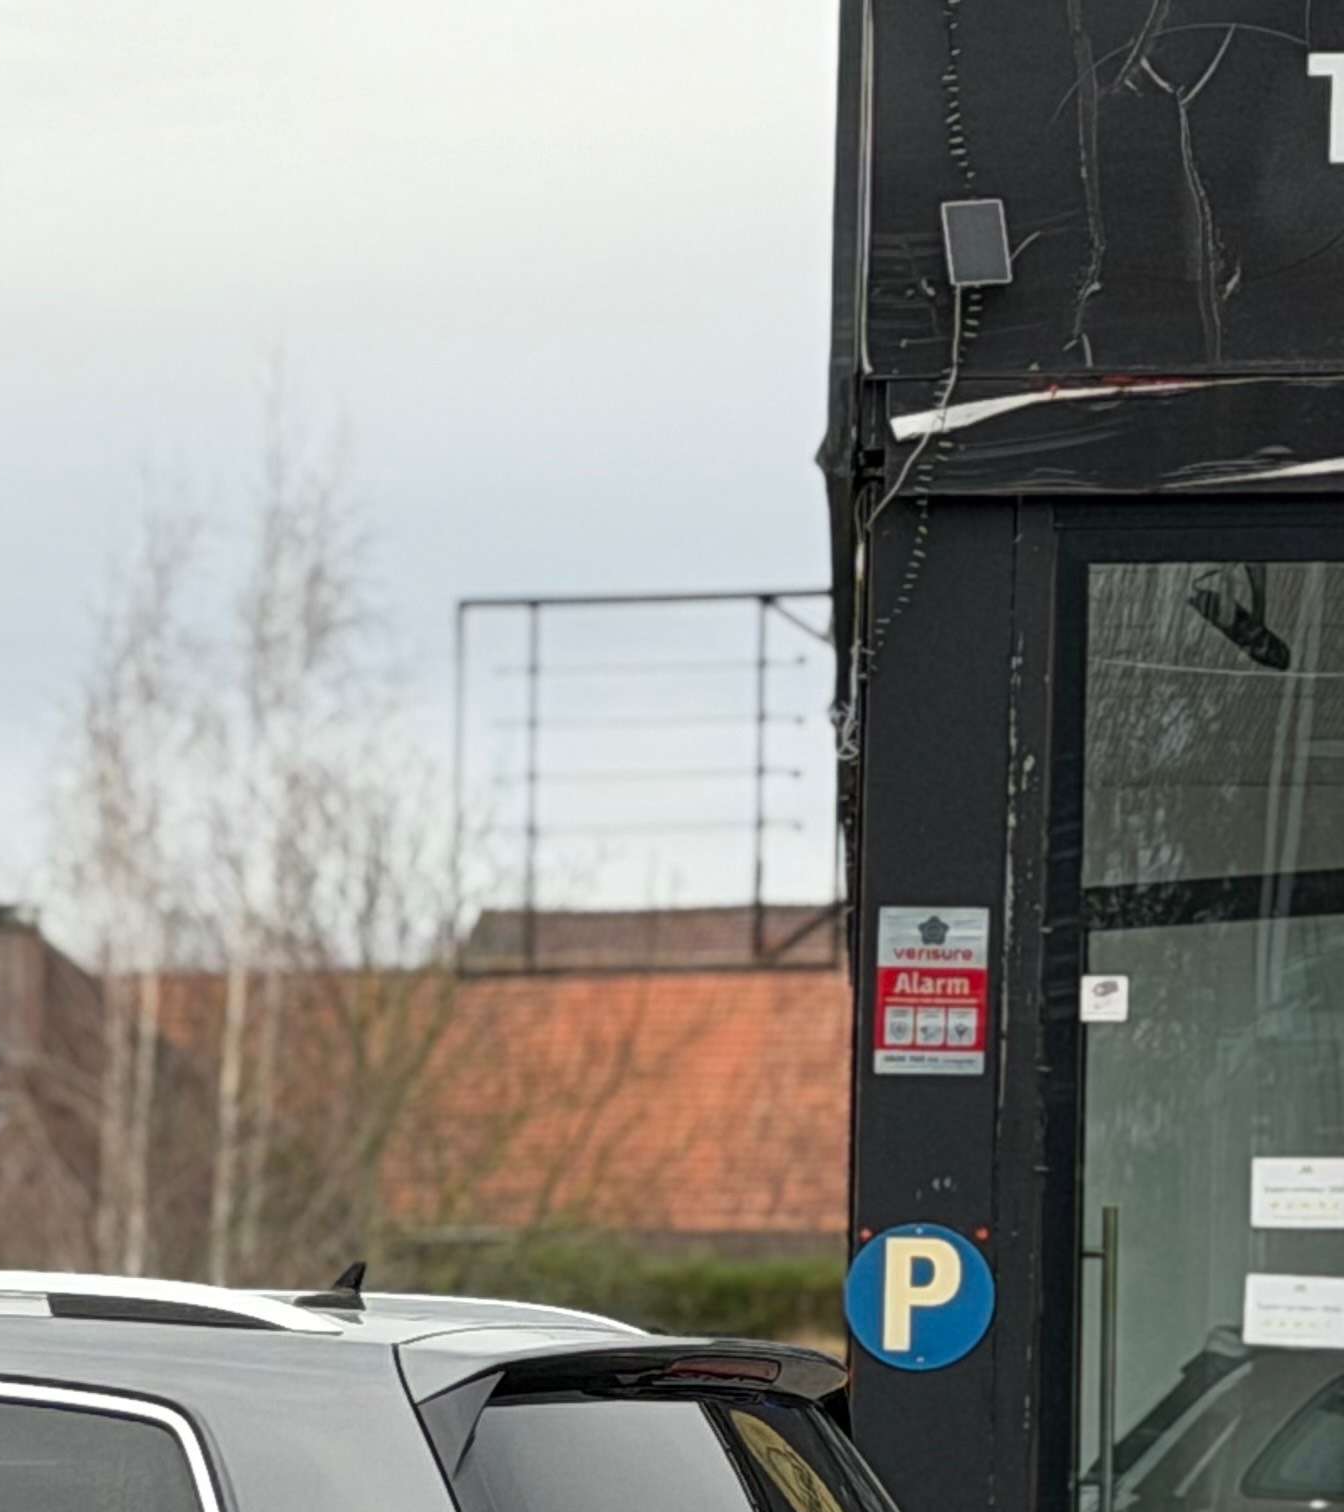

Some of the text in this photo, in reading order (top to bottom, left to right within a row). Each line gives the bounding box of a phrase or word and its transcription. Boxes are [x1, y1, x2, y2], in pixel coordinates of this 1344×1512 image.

[894, 947, 974, 961] verisure
[894, 971, 970, 995] Alarm
[881, 1236, 962, 1352] P
